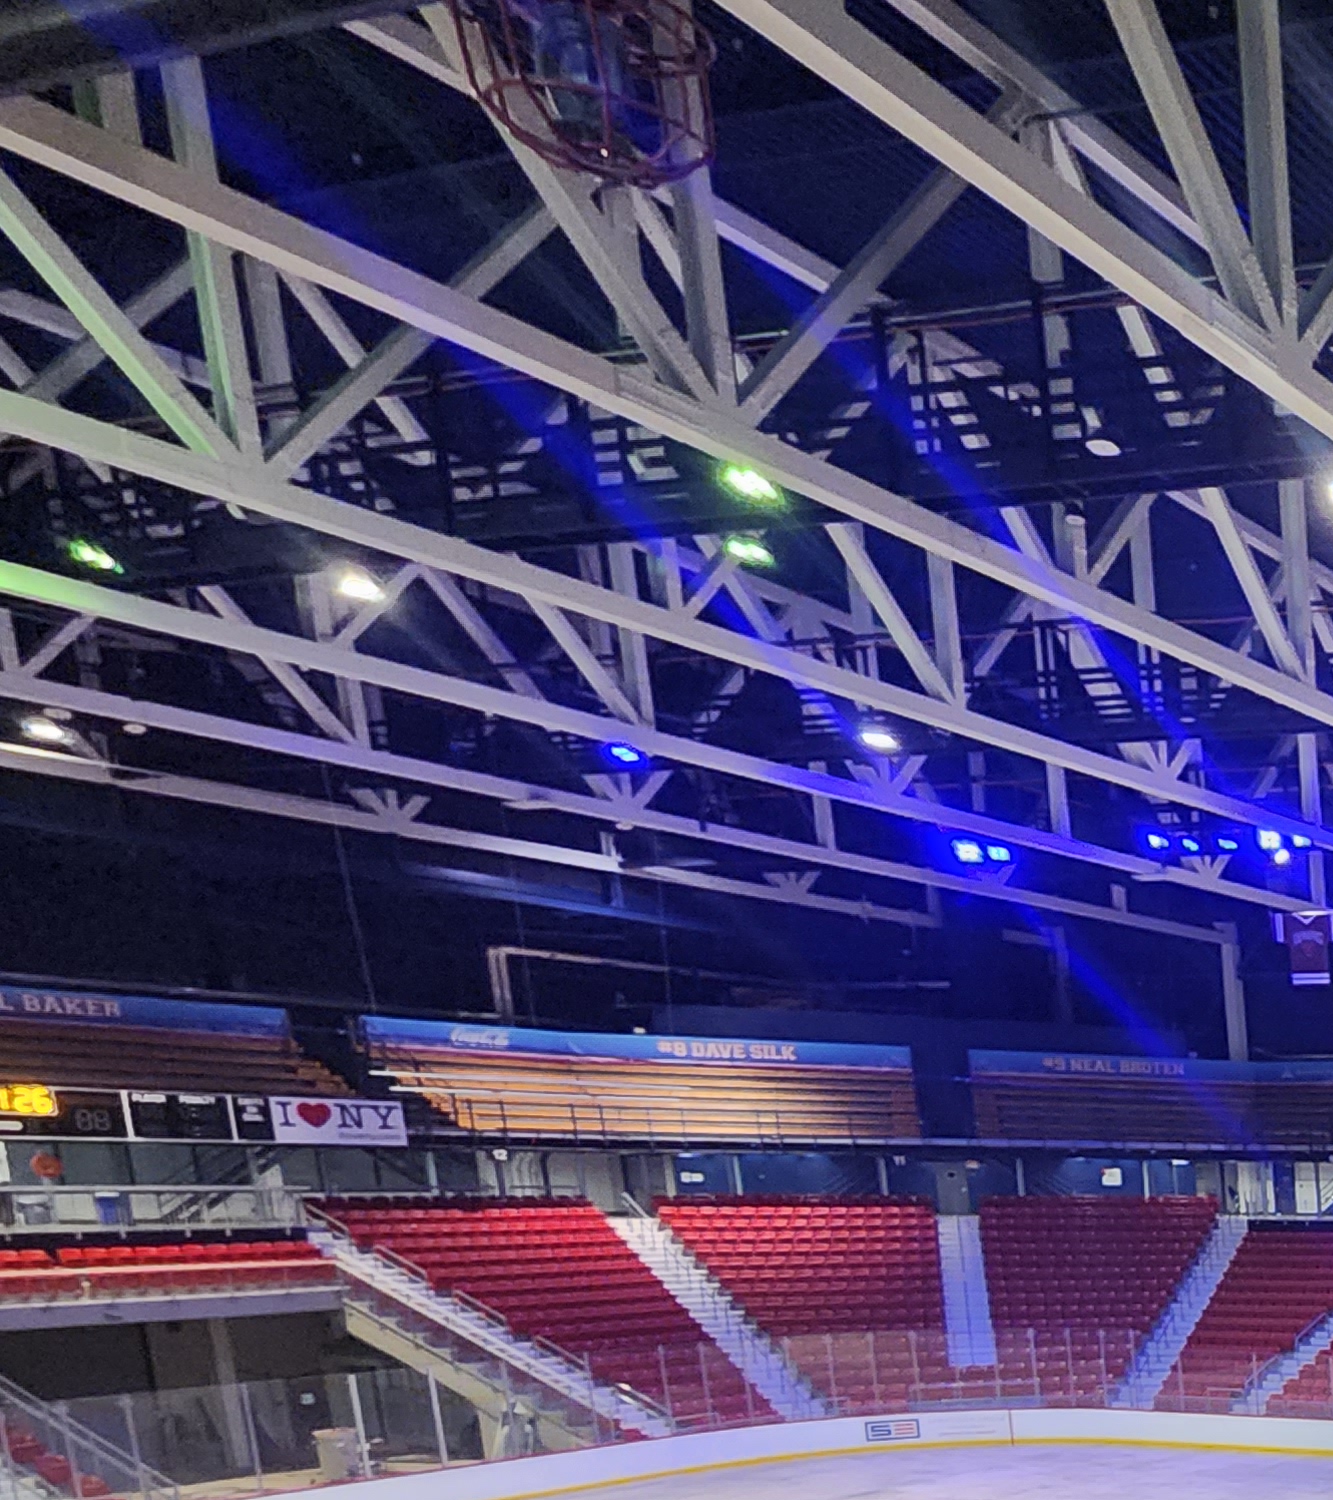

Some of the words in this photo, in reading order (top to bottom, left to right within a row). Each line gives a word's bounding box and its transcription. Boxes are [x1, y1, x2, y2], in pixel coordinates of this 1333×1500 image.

[22, 994, 120, 1017] BAKER
[690, 1041, 746, 1060] DAVE
[749, 1043, 797, 1062] SILK
[1070, 1058, 1115, 1074] NEAL
[275, 1101, 296, 1127] I
[333, 1102, 400, 1130] NY
